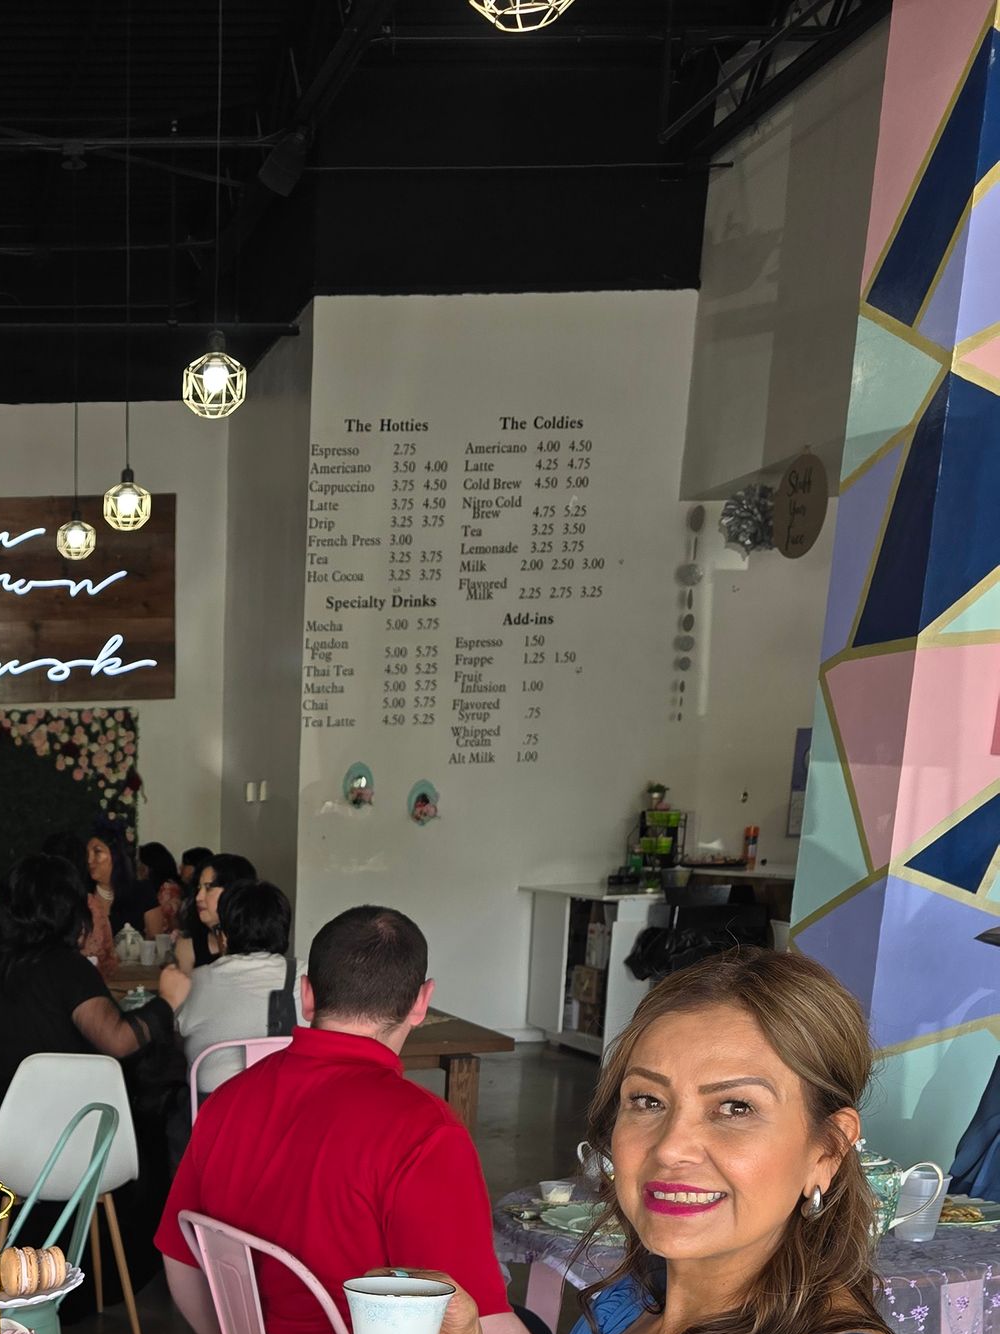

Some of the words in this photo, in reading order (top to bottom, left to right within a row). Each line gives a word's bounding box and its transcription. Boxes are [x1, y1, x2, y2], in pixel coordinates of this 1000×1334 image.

[345, 418, 372, 432] The
[380, 418, 429, 432] Hotties
[499, 416, 527, 430] The
[533, 415, 584, 429] Coldies
[310, 444, 360, 460] Espresso
[393, 443, 416, 455] 2.75
[464, 441, 527, 455] Americano
[536, 440, 560, 452] 4.00
[569, 439, 592, 451] 4.50
[310, 462, 371, 474] Americano
[392, 460, 416, 473] 3.50
[424, 460, 448, 472] 4.00
[464, 459, 494, 472] Latte
[535, 458, 558, 470] 4.25
[567, 457, 590, 469] 4.75
[309, 480, 375, 495] Cappuccino
[391, 478, 415, 491] 3.75
[423, 478, 447, 490] 4.50
[463, 477, 489, 490] Cold
[492, 477, 522, 490] Brew
[534, 477, 558, 489] 4.50
[565, 476, 589, 488] 5.00
[309, 499, 339, 511] Latte
[391, 498, 414, 510] 3.75
[422, 497, 446, 509] 4.50
[462, 496, 493, 509] Nitro
[495, 495, 522, 508] Cold
[472, 506, 500, 519] Brew
[532, 505, 556, 518] 4.75
[563, 504, 587, 517] 5.25
[308, 517, 335, 532] Drip
[390, 516, 413, 528] 3.25
[421, 515, 444, 527] 3.75
[461, 524, 482, 537] Tea
[531, 523, 554, 535] 3.25
[562, 522, 585, 535] 3.50
[308, 534, 348, 547] French
[351, 534, 381, 546] Press
[389, 534, 412, 546] 3.00
[460, 542, 518, 555] Lemonade
[530, 541, 553, 553] 3.25
[562, 540, 584, 552] 3.75
[308, 553, 328, 565] Tea
[389, 551, 412, 563] 3.25
[420, 550, 443, 563] 3.75
[459, 559, 487, 572] Milk
[520, 558, 544, 571] 2.00
[551, 558, 574, 570] 2.50
[582, 557, 605, 569] 3.00
[307, 570, 329, 582] Hot
[332, 570, 364, 582] Cocoa
[388, 569, 411, 581] 3.25
[419, 568, 442, 581] 3.75
[458, 577, 507, 590] Flavored
[466, 588, 493, 600] Milk
[518, 587, 542, 599] 2.25
[550, 586, 572, 598] 2.75
[580, 585, 602, 598] 3.25
[326, 595, 386, 611] Specialty
[392, 595, 437, 608] Drinks
[306, 619, 343, 632] Mocha
[386, 618, 409, 631] 5.00
[417, 618, 440, 630] 5.75
[503, 612, 554, 626] Add-ins
[305, 637, 349, 649] London
[455, 636, 503, 650] Espresso
[524, 635, 545, 647] 1.50
[310, 648, 333, 662] Fog
[385, 646, 408, 658] 5.00
[416, 645, 438, 658] 5.75
[454, 653, 494, 667] Frappe
[523, 652, 545, 664] 1.25
[554, 651, 576, 663] 1.50
[304, 665, 331, 677] Thai
[333, 664, 354, 677] Tea
[384, 663, 407, 675] 4.50
[415, 663, 437, 674] 5.25
[453, 670, 482, 683] Fruit
[304, 682, 345, 694] Matcha
[383, 680, 406, 692] 5.00
[414, 680, 437, 691] 5.75
[461, 681, 506, 694] Infusion
[522, 680, 544, 692] 1.00
[302, 698, 329, 711] Chai
[382, 697, 405, 708] 5.00
[413, 696, 436, 708] 5.75
[452, 698, 500, 710] Flavored
[302, 716, 324, 728] Tea
[326, 715, 356, 727] Latte
[382, 713, 405, 726] 4.50
[412, 713, 435, 725] 5.25
[458, 709, 490, 723] Syrup
[524, 707, 541, 719] .75
[451, 725, 500, 739] Whipped
[456, 736, 491, 748] Cream
[522, 733, 538, 745] .75
[449, 752, 466, 764] Alt
[468, 751, 495, 763] Milk
[516, 750, 538, 762] 1.00
